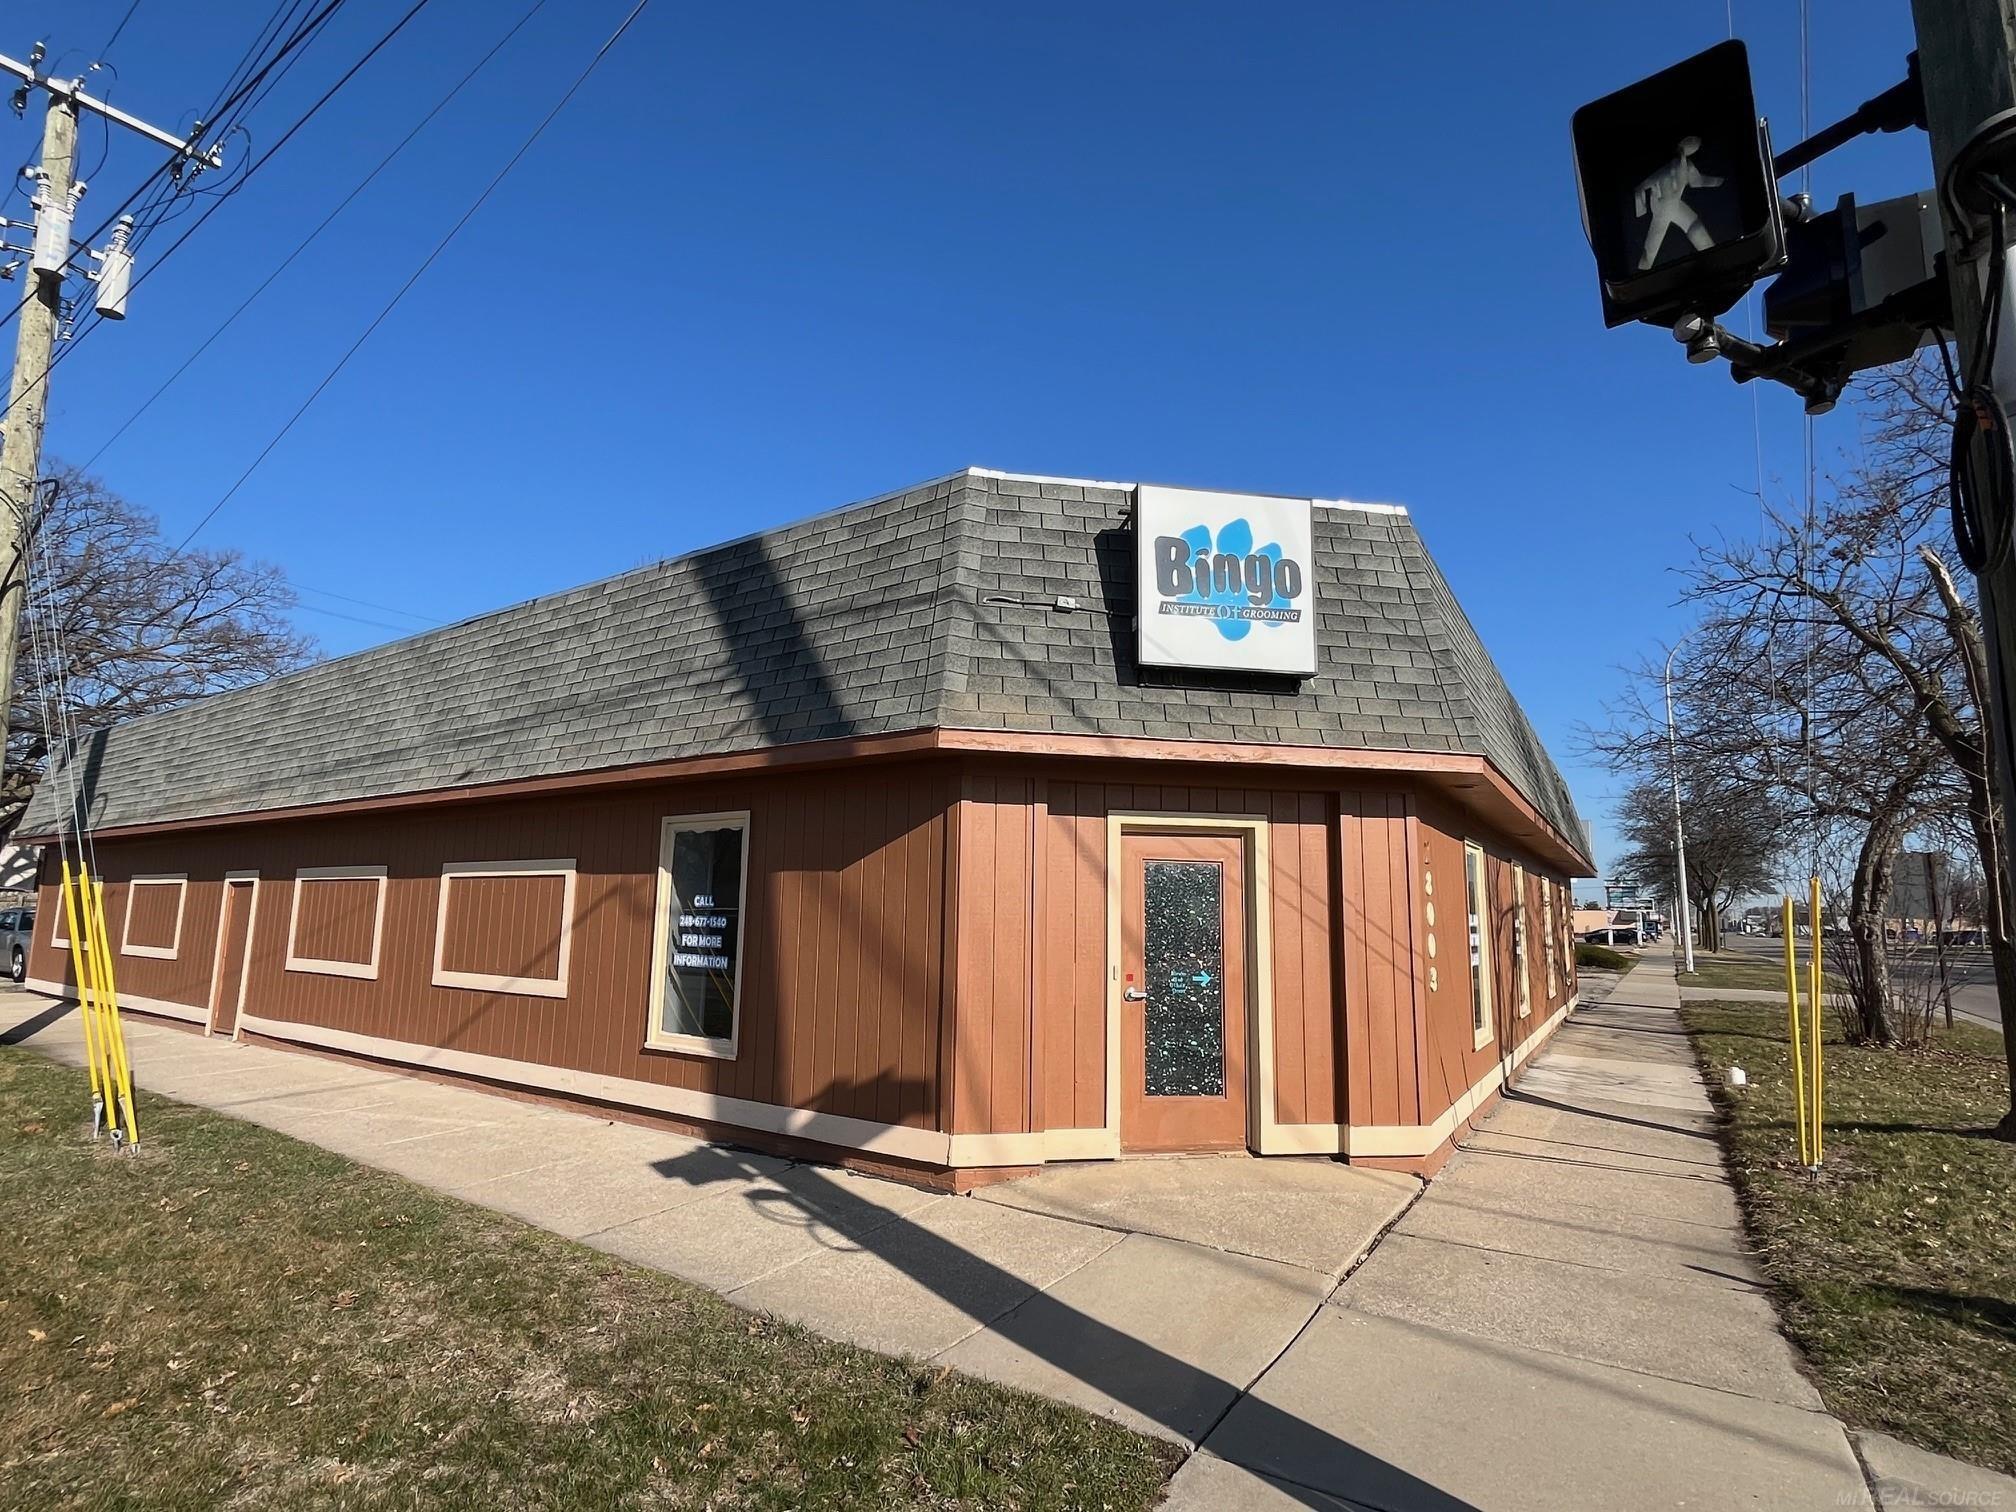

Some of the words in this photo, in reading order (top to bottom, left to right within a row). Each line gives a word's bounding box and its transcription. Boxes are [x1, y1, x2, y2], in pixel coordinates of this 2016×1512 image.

[1154, 536, 1302, 606] Bingo
[1161, 603, 1216, 616] INSTITUTE
[1242, 609, 1298, 620] GROOMING
[694, 895, 714, 907] CALL
[682, 934, 698, 947] FOR
[699, 935, 722, 948] MORE
[673, 953, 728, 969] INFORMATION
